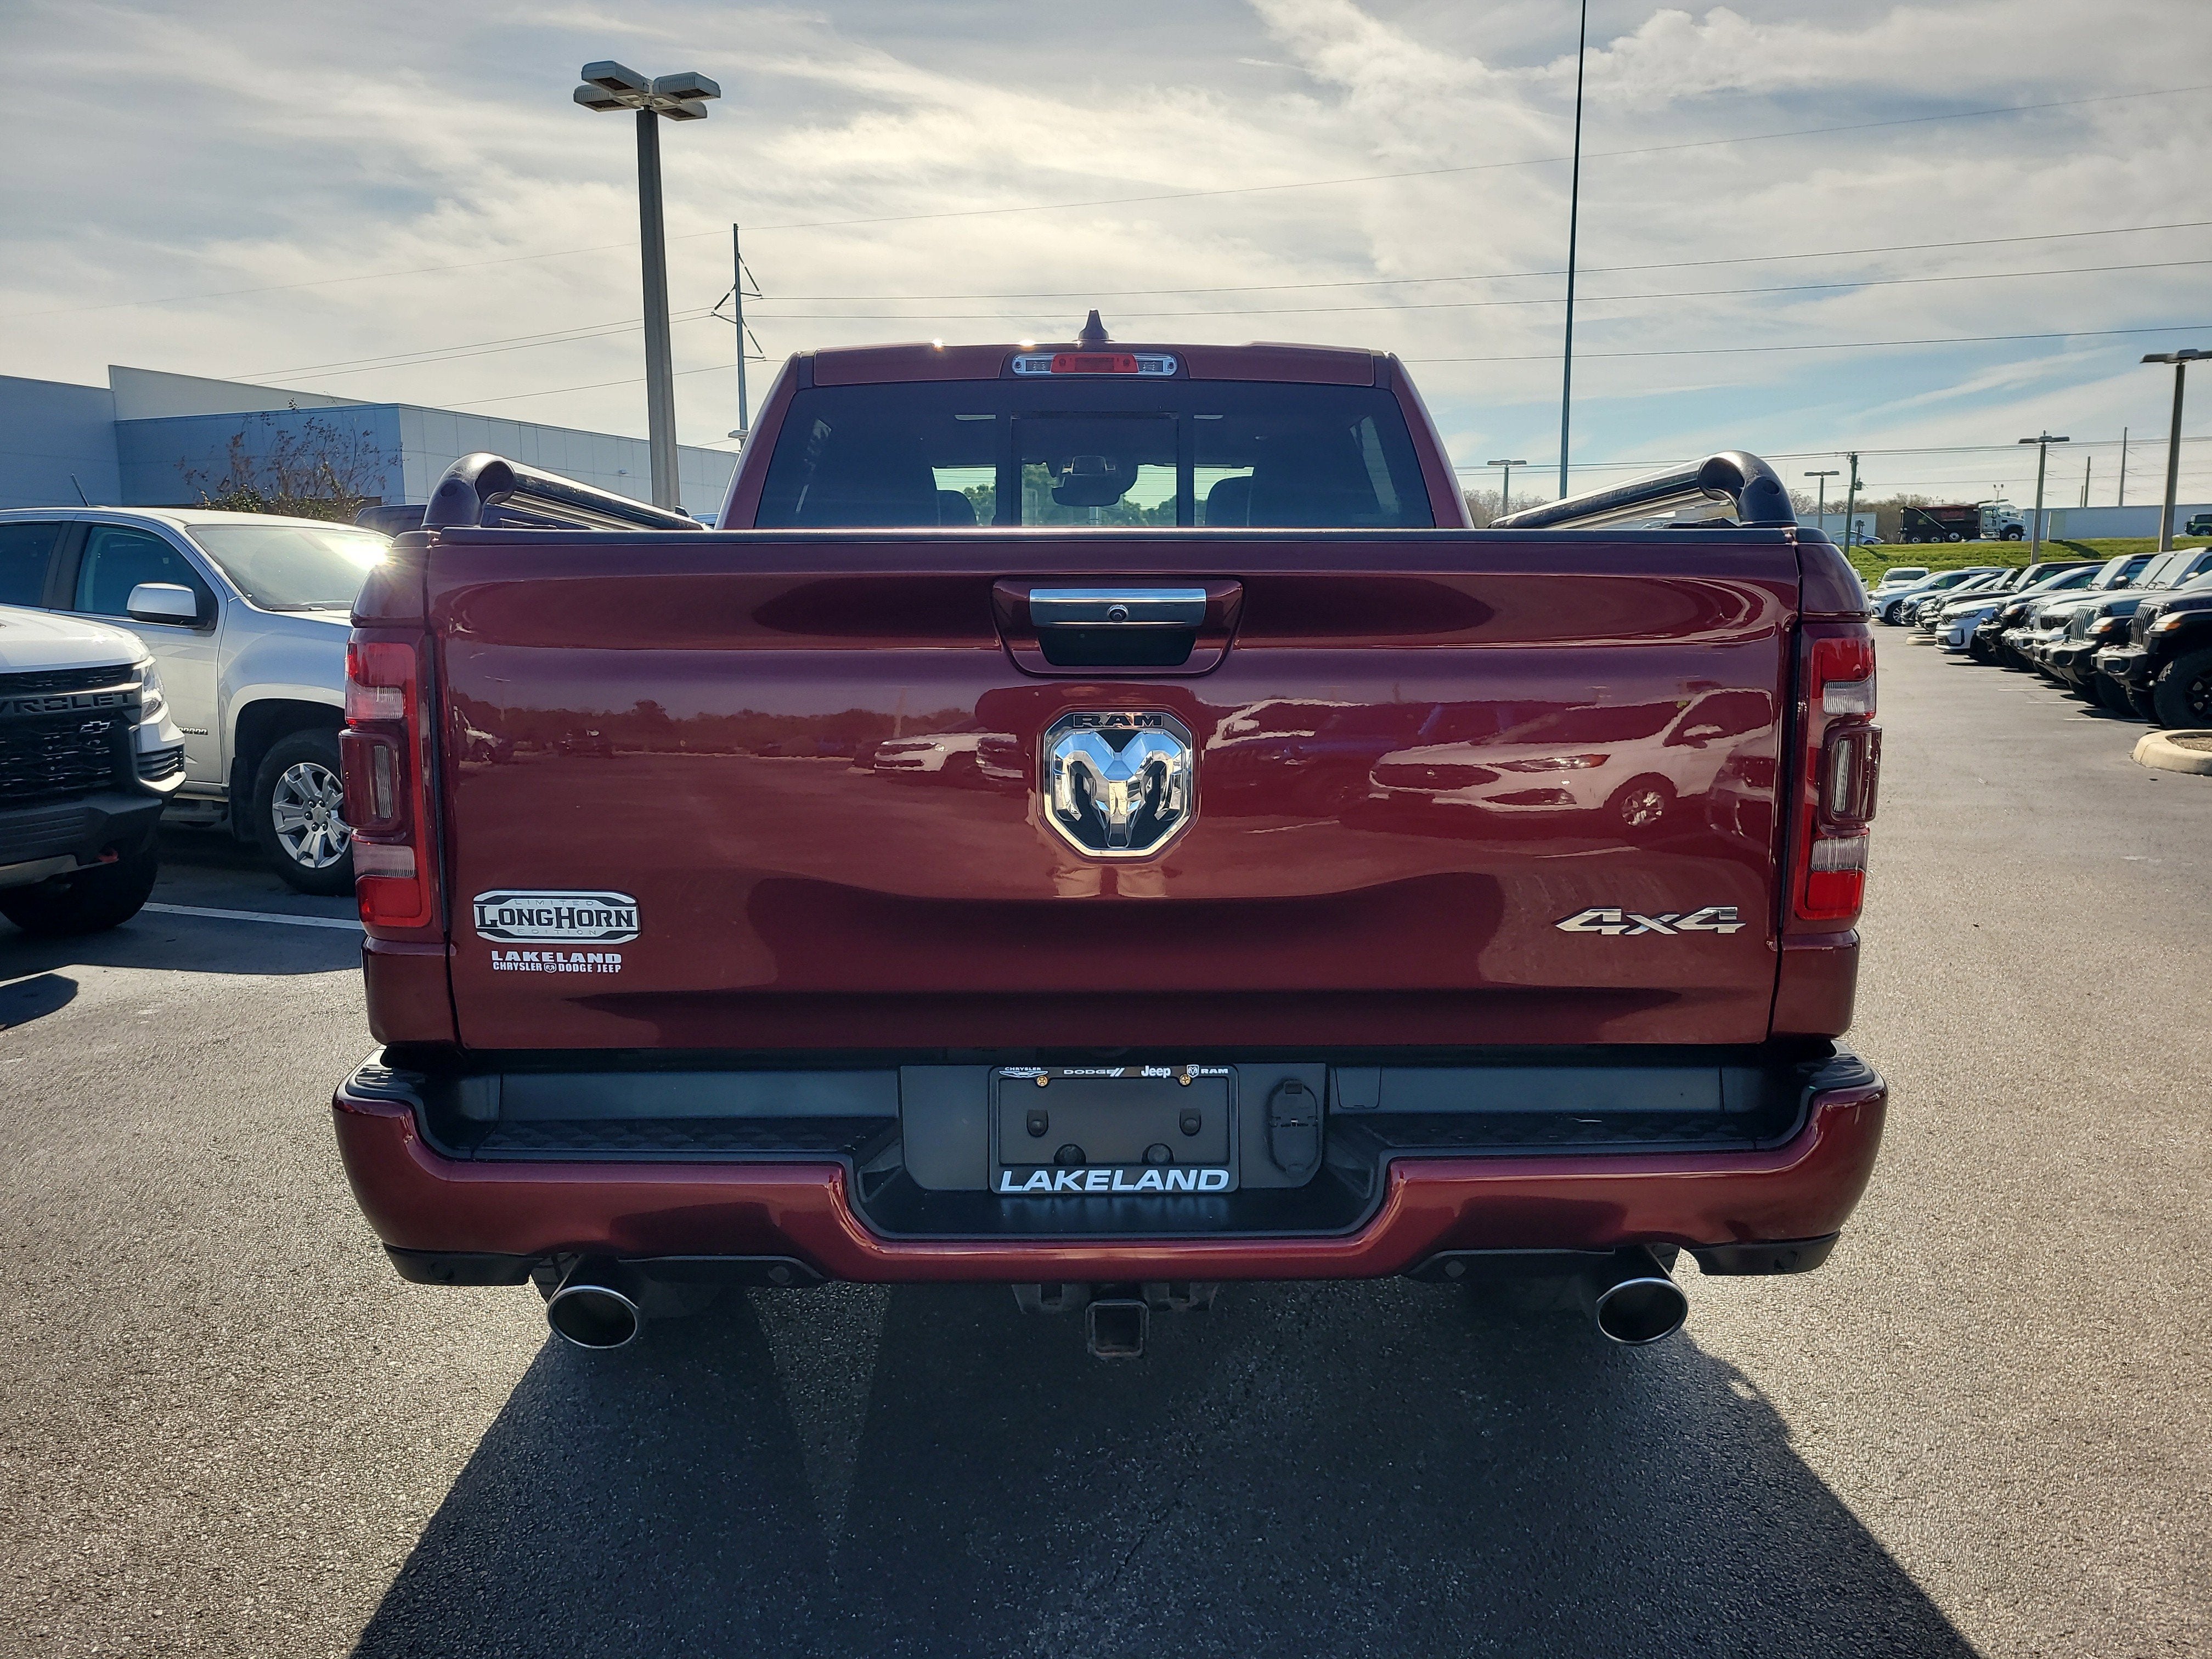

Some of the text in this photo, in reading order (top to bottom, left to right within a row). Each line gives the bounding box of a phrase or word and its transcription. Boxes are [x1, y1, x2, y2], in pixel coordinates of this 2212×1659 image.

[1073, 714, 1164, 727] RAM
[491, 950, 622, 963] LAKELAND
[493, 962, 621, 973] CHRYSLER DODGE JEEP
[1141, 1065, 1171, 1078] Jeep
[1000, 1169, 1229, 1191] LAKELAND
